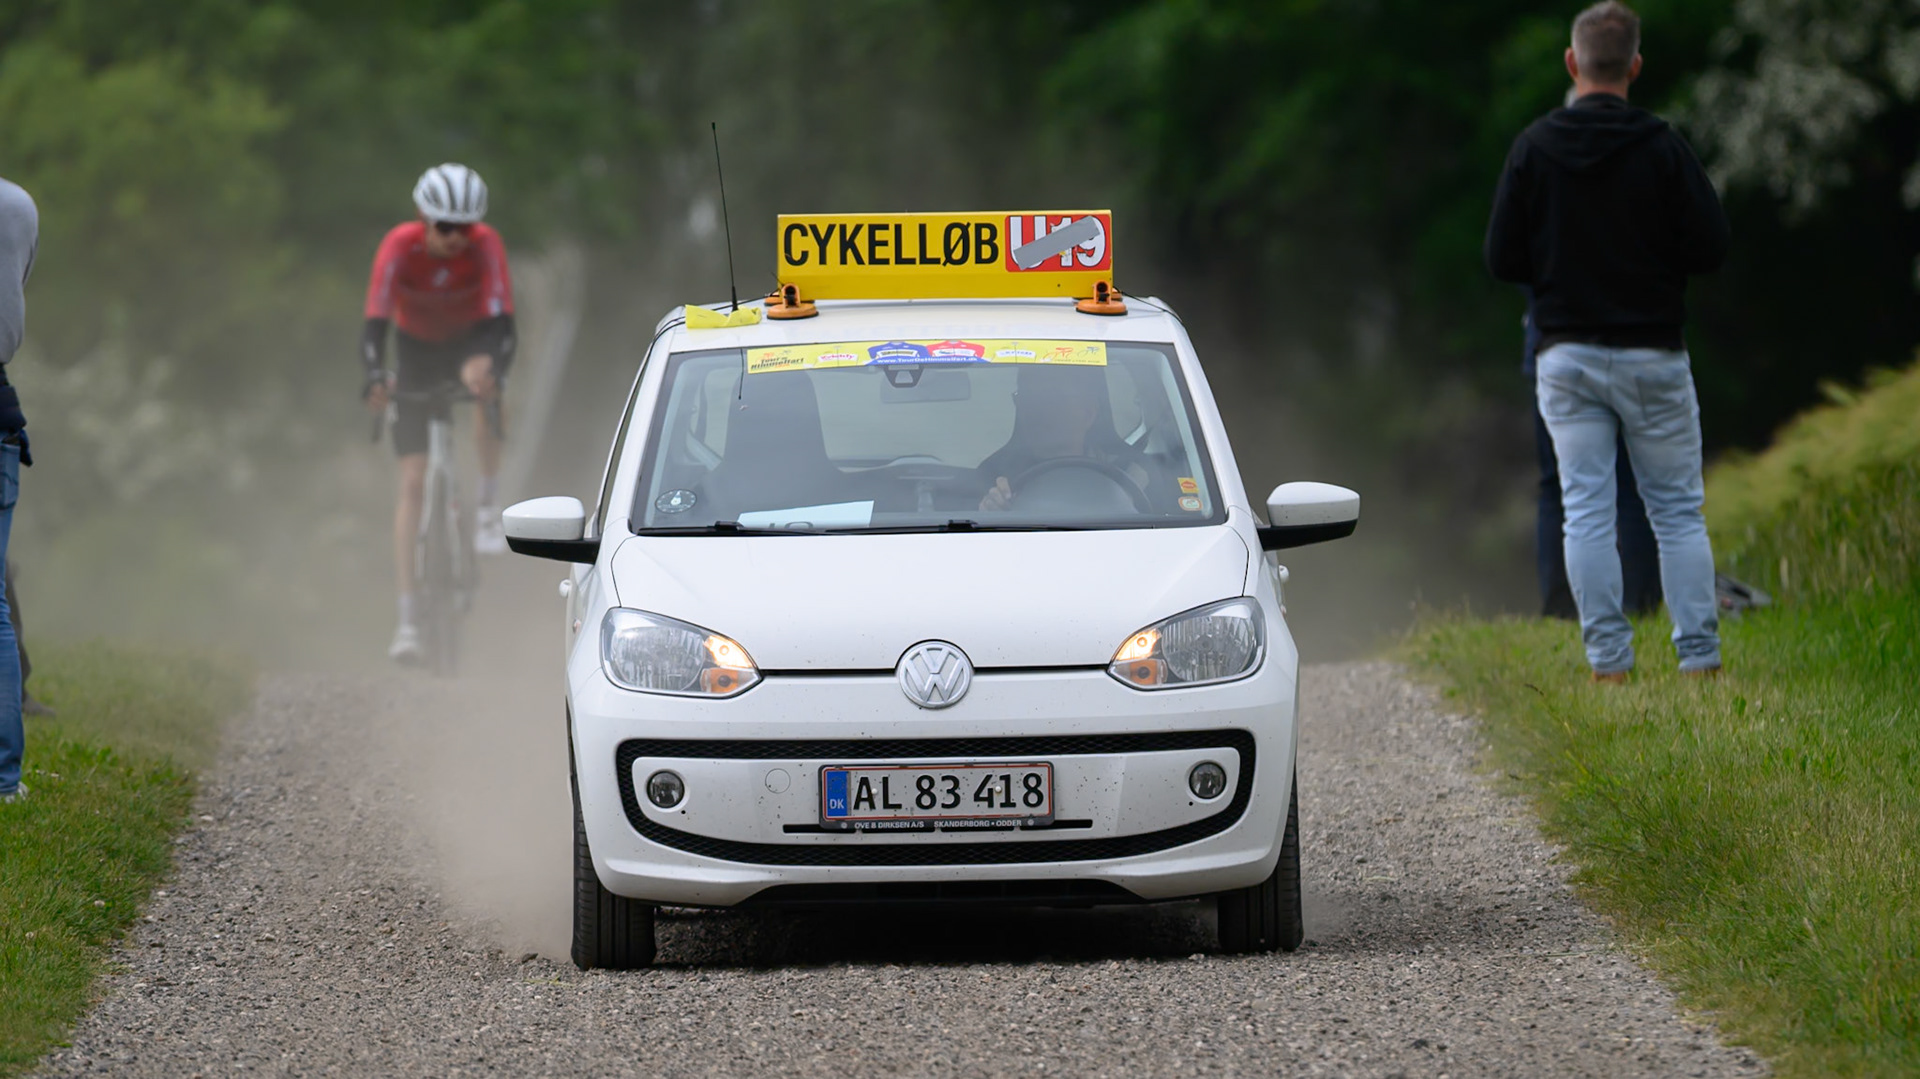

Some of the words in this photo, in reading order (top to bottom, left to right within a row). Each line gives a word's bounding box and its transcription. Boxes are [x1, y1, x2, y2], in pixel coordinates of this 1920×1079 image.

[783, 221, 999, 267] CYKELLØB
[853, 776, 902, 810] AL
[915, 774, 961, 810] 83
[973, 773, 1045, 809] 418
[829, 798, 845, 810] DK
[854, 821, 870, 829] OVE
[878, 821, 910, 829] DIRKSEN
[911, 820, 925, 828] A/S
[933, 820, 990, 828] SKANDERBORG
[996, 819, 1022, 827] ODDER
